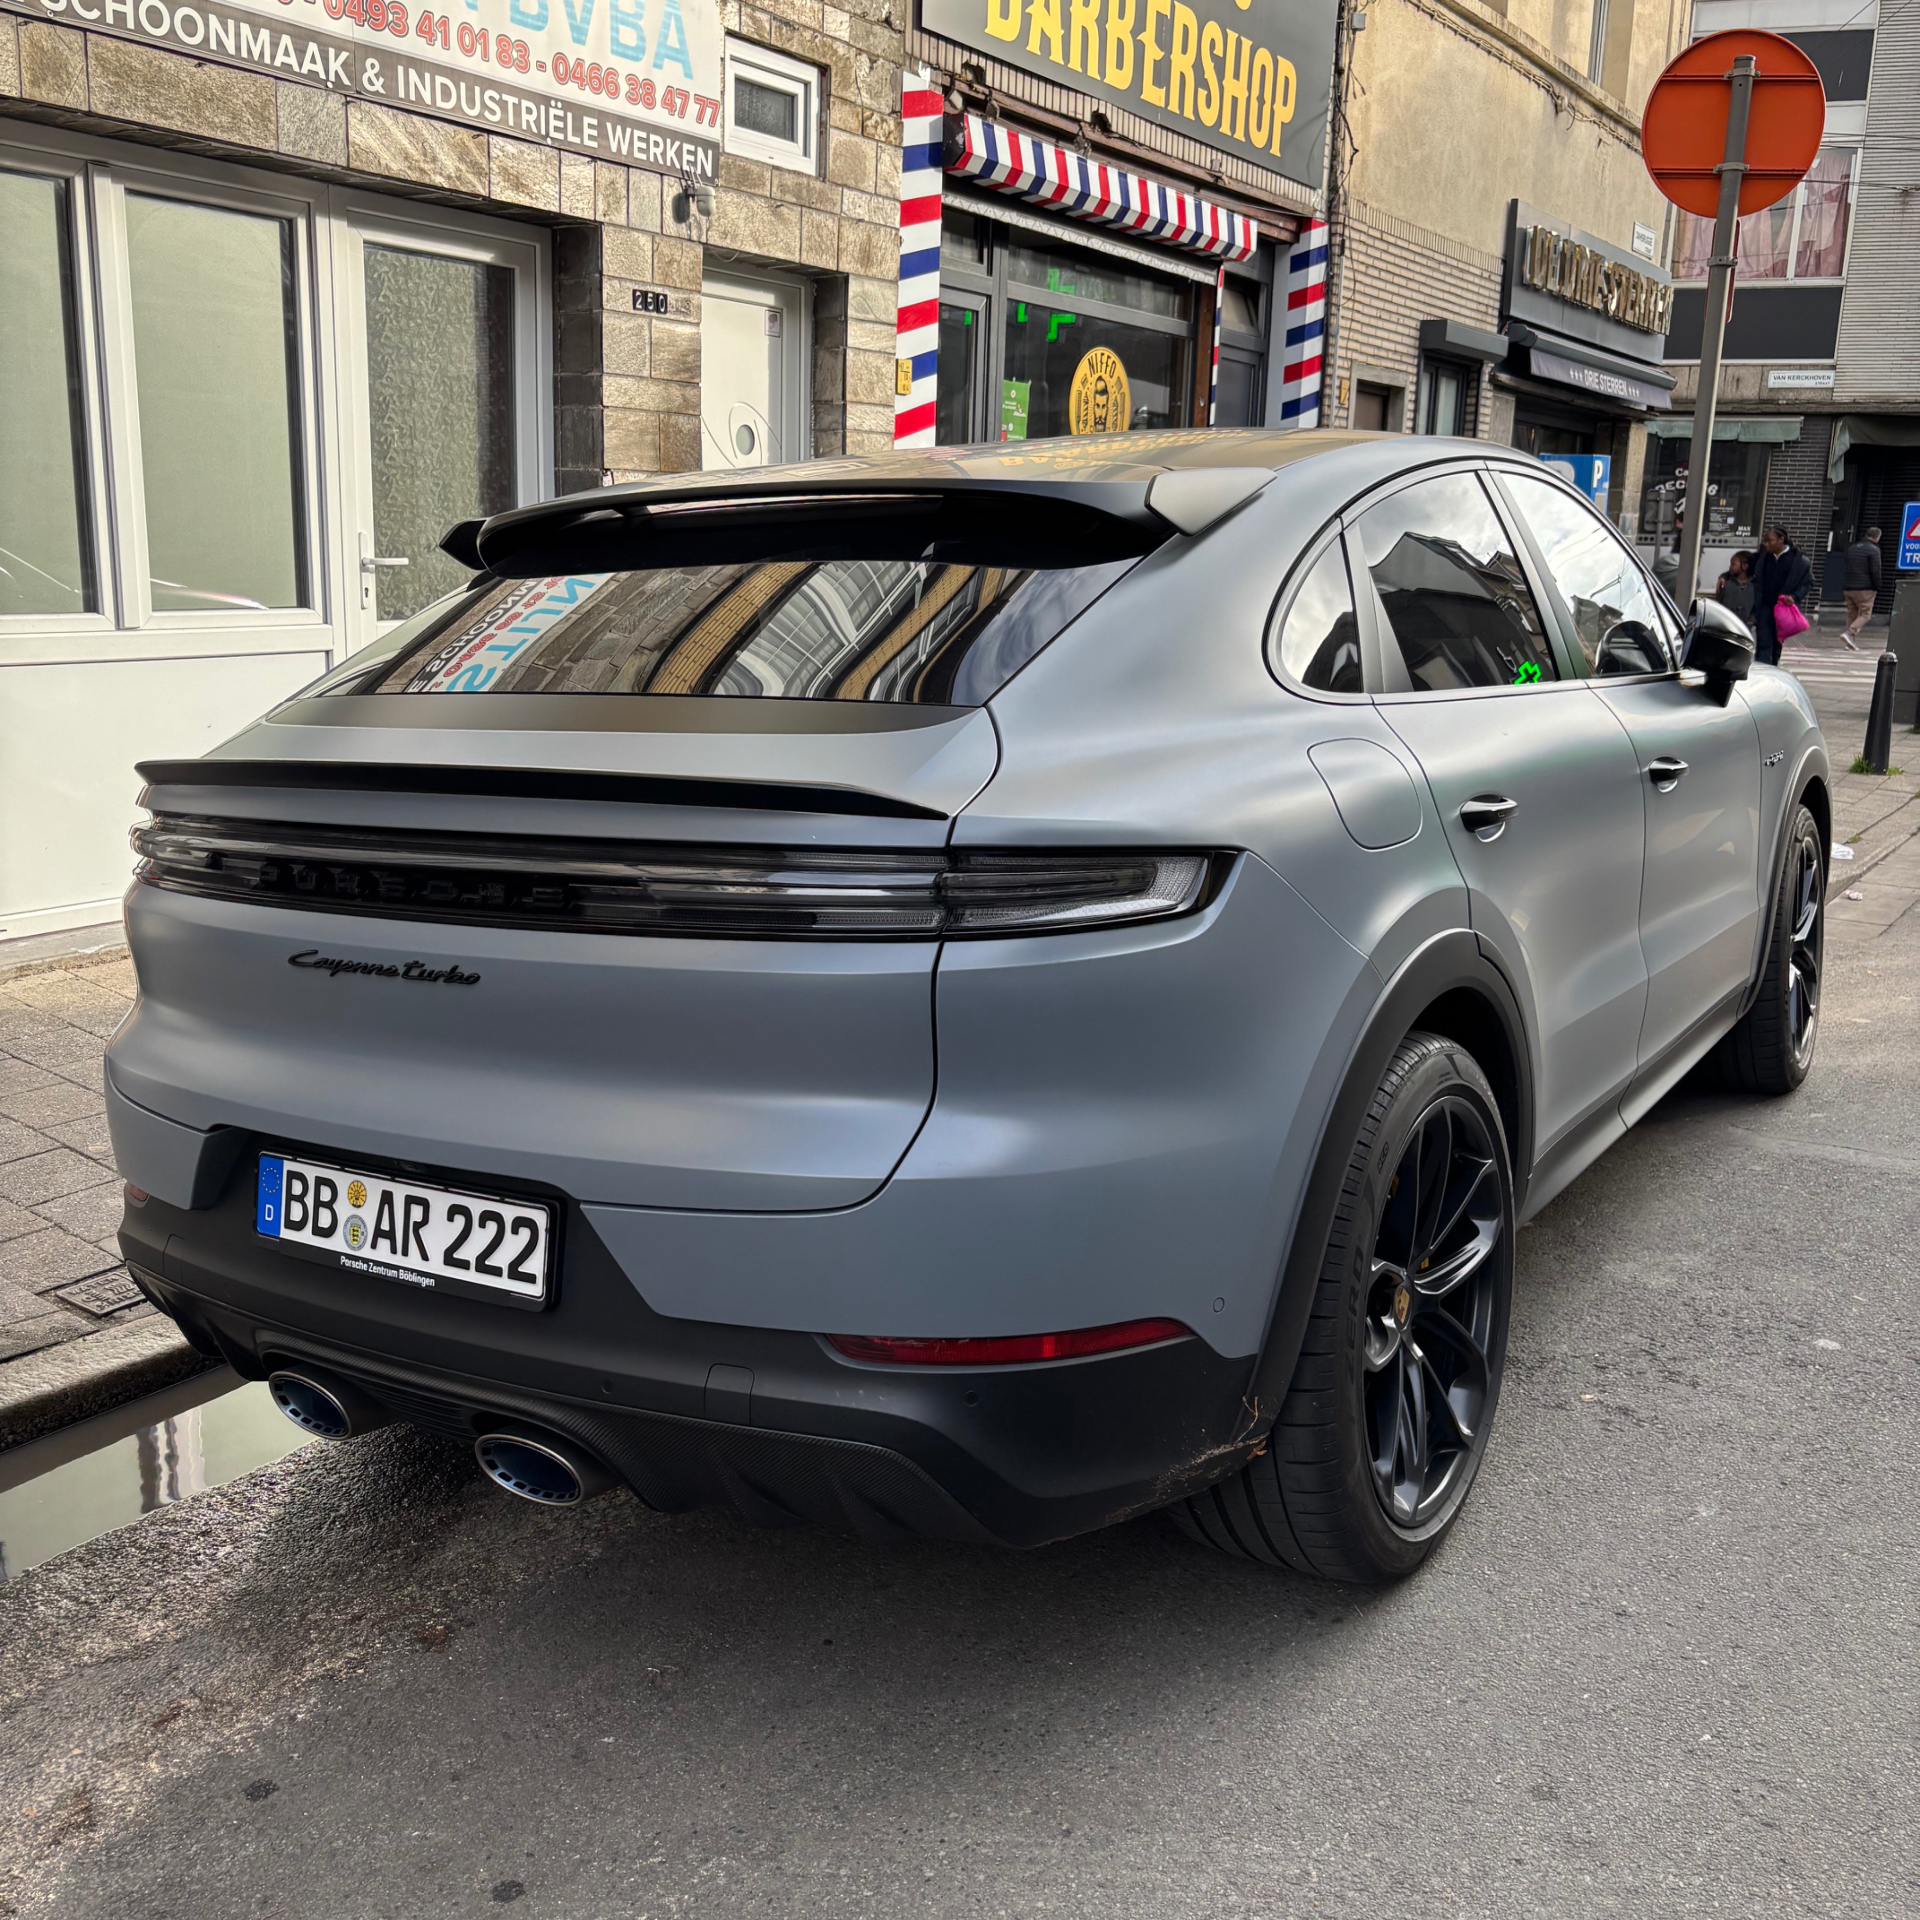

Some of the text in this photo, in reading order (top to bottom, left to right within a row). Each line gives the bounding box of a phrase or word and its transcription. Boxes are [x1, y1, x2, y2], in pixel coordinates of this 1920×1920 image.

[416, 10, 450, 50] 41
[457, 22, 489, 63] 01
[496, 34, 530, 74] 83
[553, 52, 620, 99] 0466
[625, 74, 656, 109] 38
[662, 83, 690, 120] 47
[694, 94, 720, 128] 77
[362, 57, 386, 96] &
[397, 65, 598, 149] INDUSTRIËLE
[606, 121, 713, 178] WERKEN
[635, 290, 666, 313] 250
[1087, 352, 1117, 378] NIFFO
[1584, 368, 1628, 396] DRIE STERREN
[1592, 460, 1603, 488] P
[288, 950, 400, 977] Cayenne
[264, 1204, 274, 1221] D
[284, 1169, 339, 1239] BB
[370, 1189, 431, 1262] AR
[443, 1203, 540, 1285] 222
[340, 1256, 435, 1287] Porsche Zentrum Böblingen
